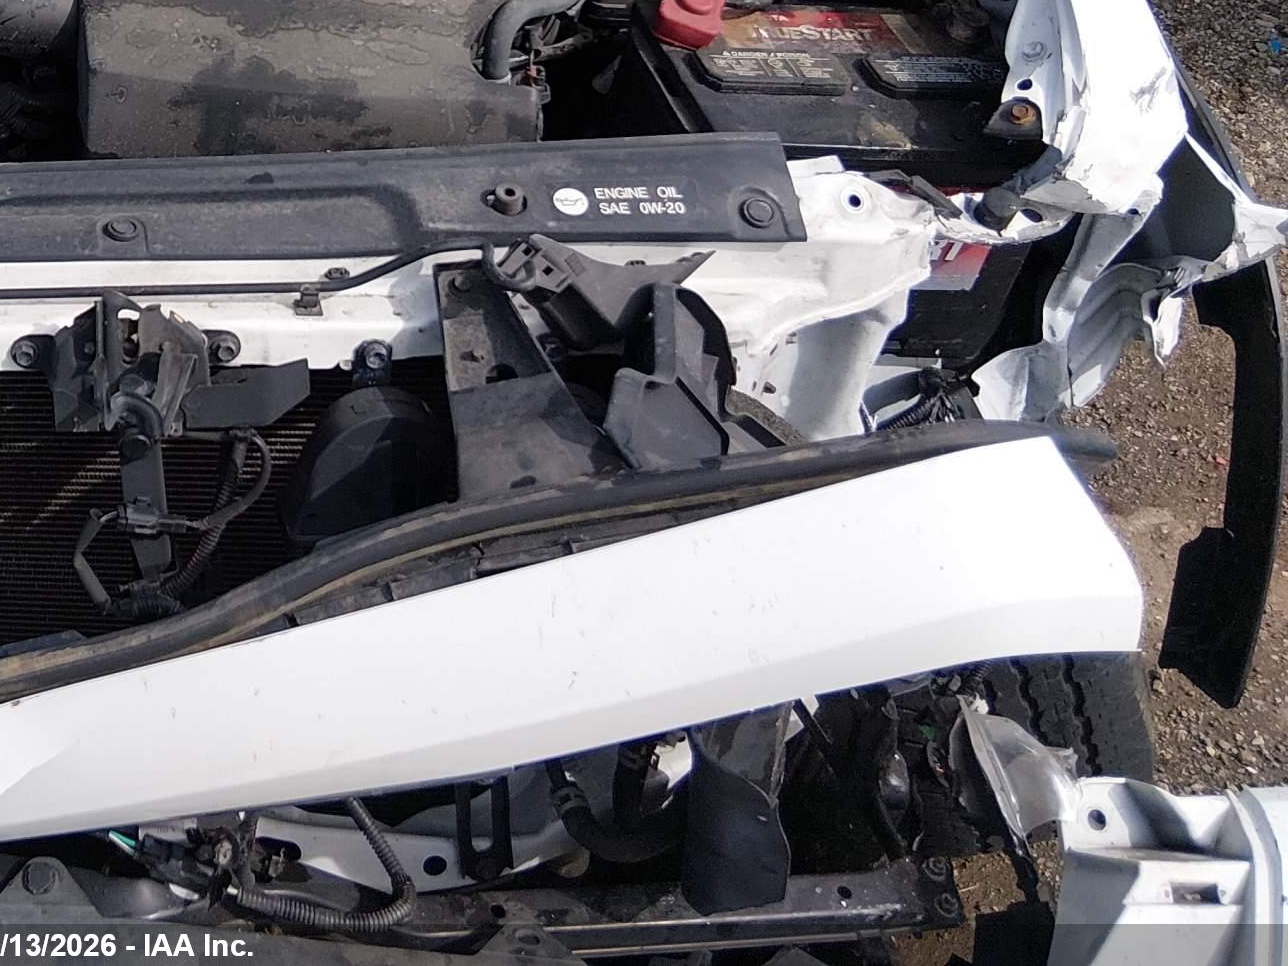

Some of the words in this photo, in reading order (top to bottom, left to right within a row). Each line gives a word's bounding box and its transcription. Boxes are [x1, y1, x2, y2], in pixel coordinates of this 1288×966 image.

[594, 186, 649, 199] ENGINE
[657, 186, 683, 198] OIL
[599, 202, 631, 214] SAE
[639, 202, 686, 214] 0W-20
